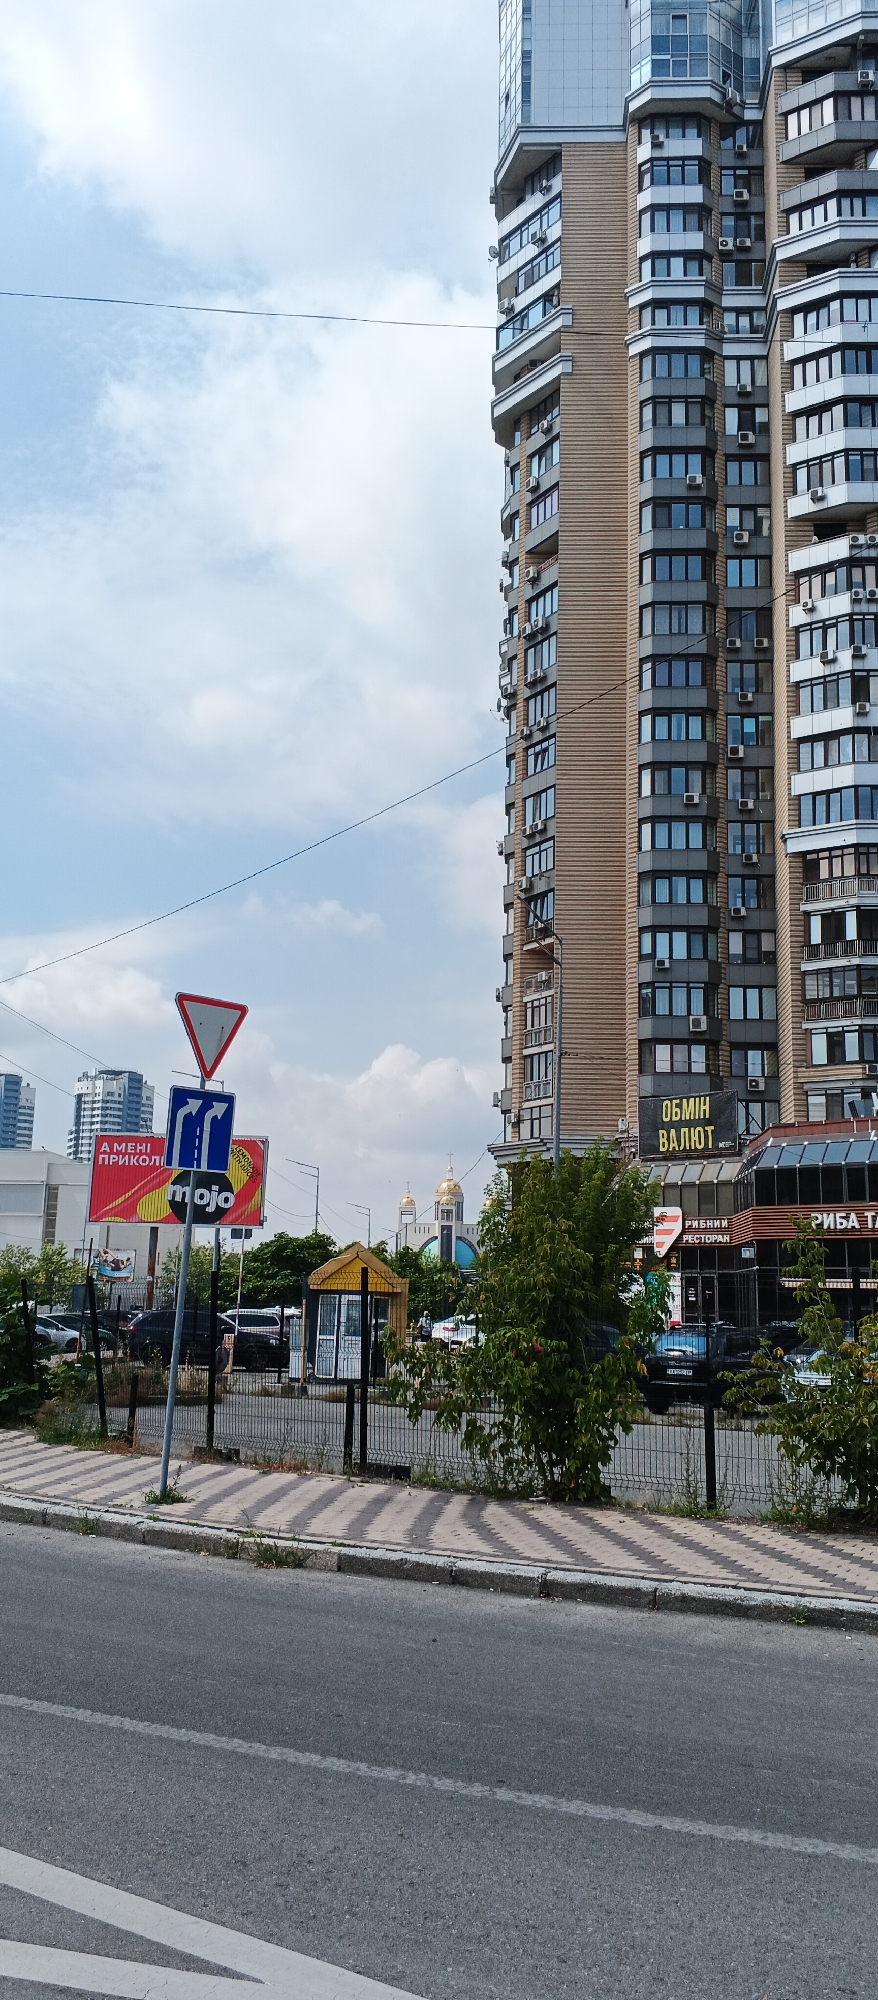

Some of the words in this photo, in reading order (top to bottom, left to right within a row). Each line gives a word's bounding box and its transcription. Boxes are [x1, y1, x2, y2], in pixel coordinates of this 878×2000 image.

[662, 1096, 710, 1122] ОБМІН
[99, 1142, 110, 1153] А
[113, 1142, 151, 1154] МЕНІ
[658, 1126, 715, 1152] ВАЛЮТ
[167, 1184, 236, 1213] mojo
[811, 1212, 861, 1230] РИБА
[682, 1234, 730, 1244] РЕСТОРАН
